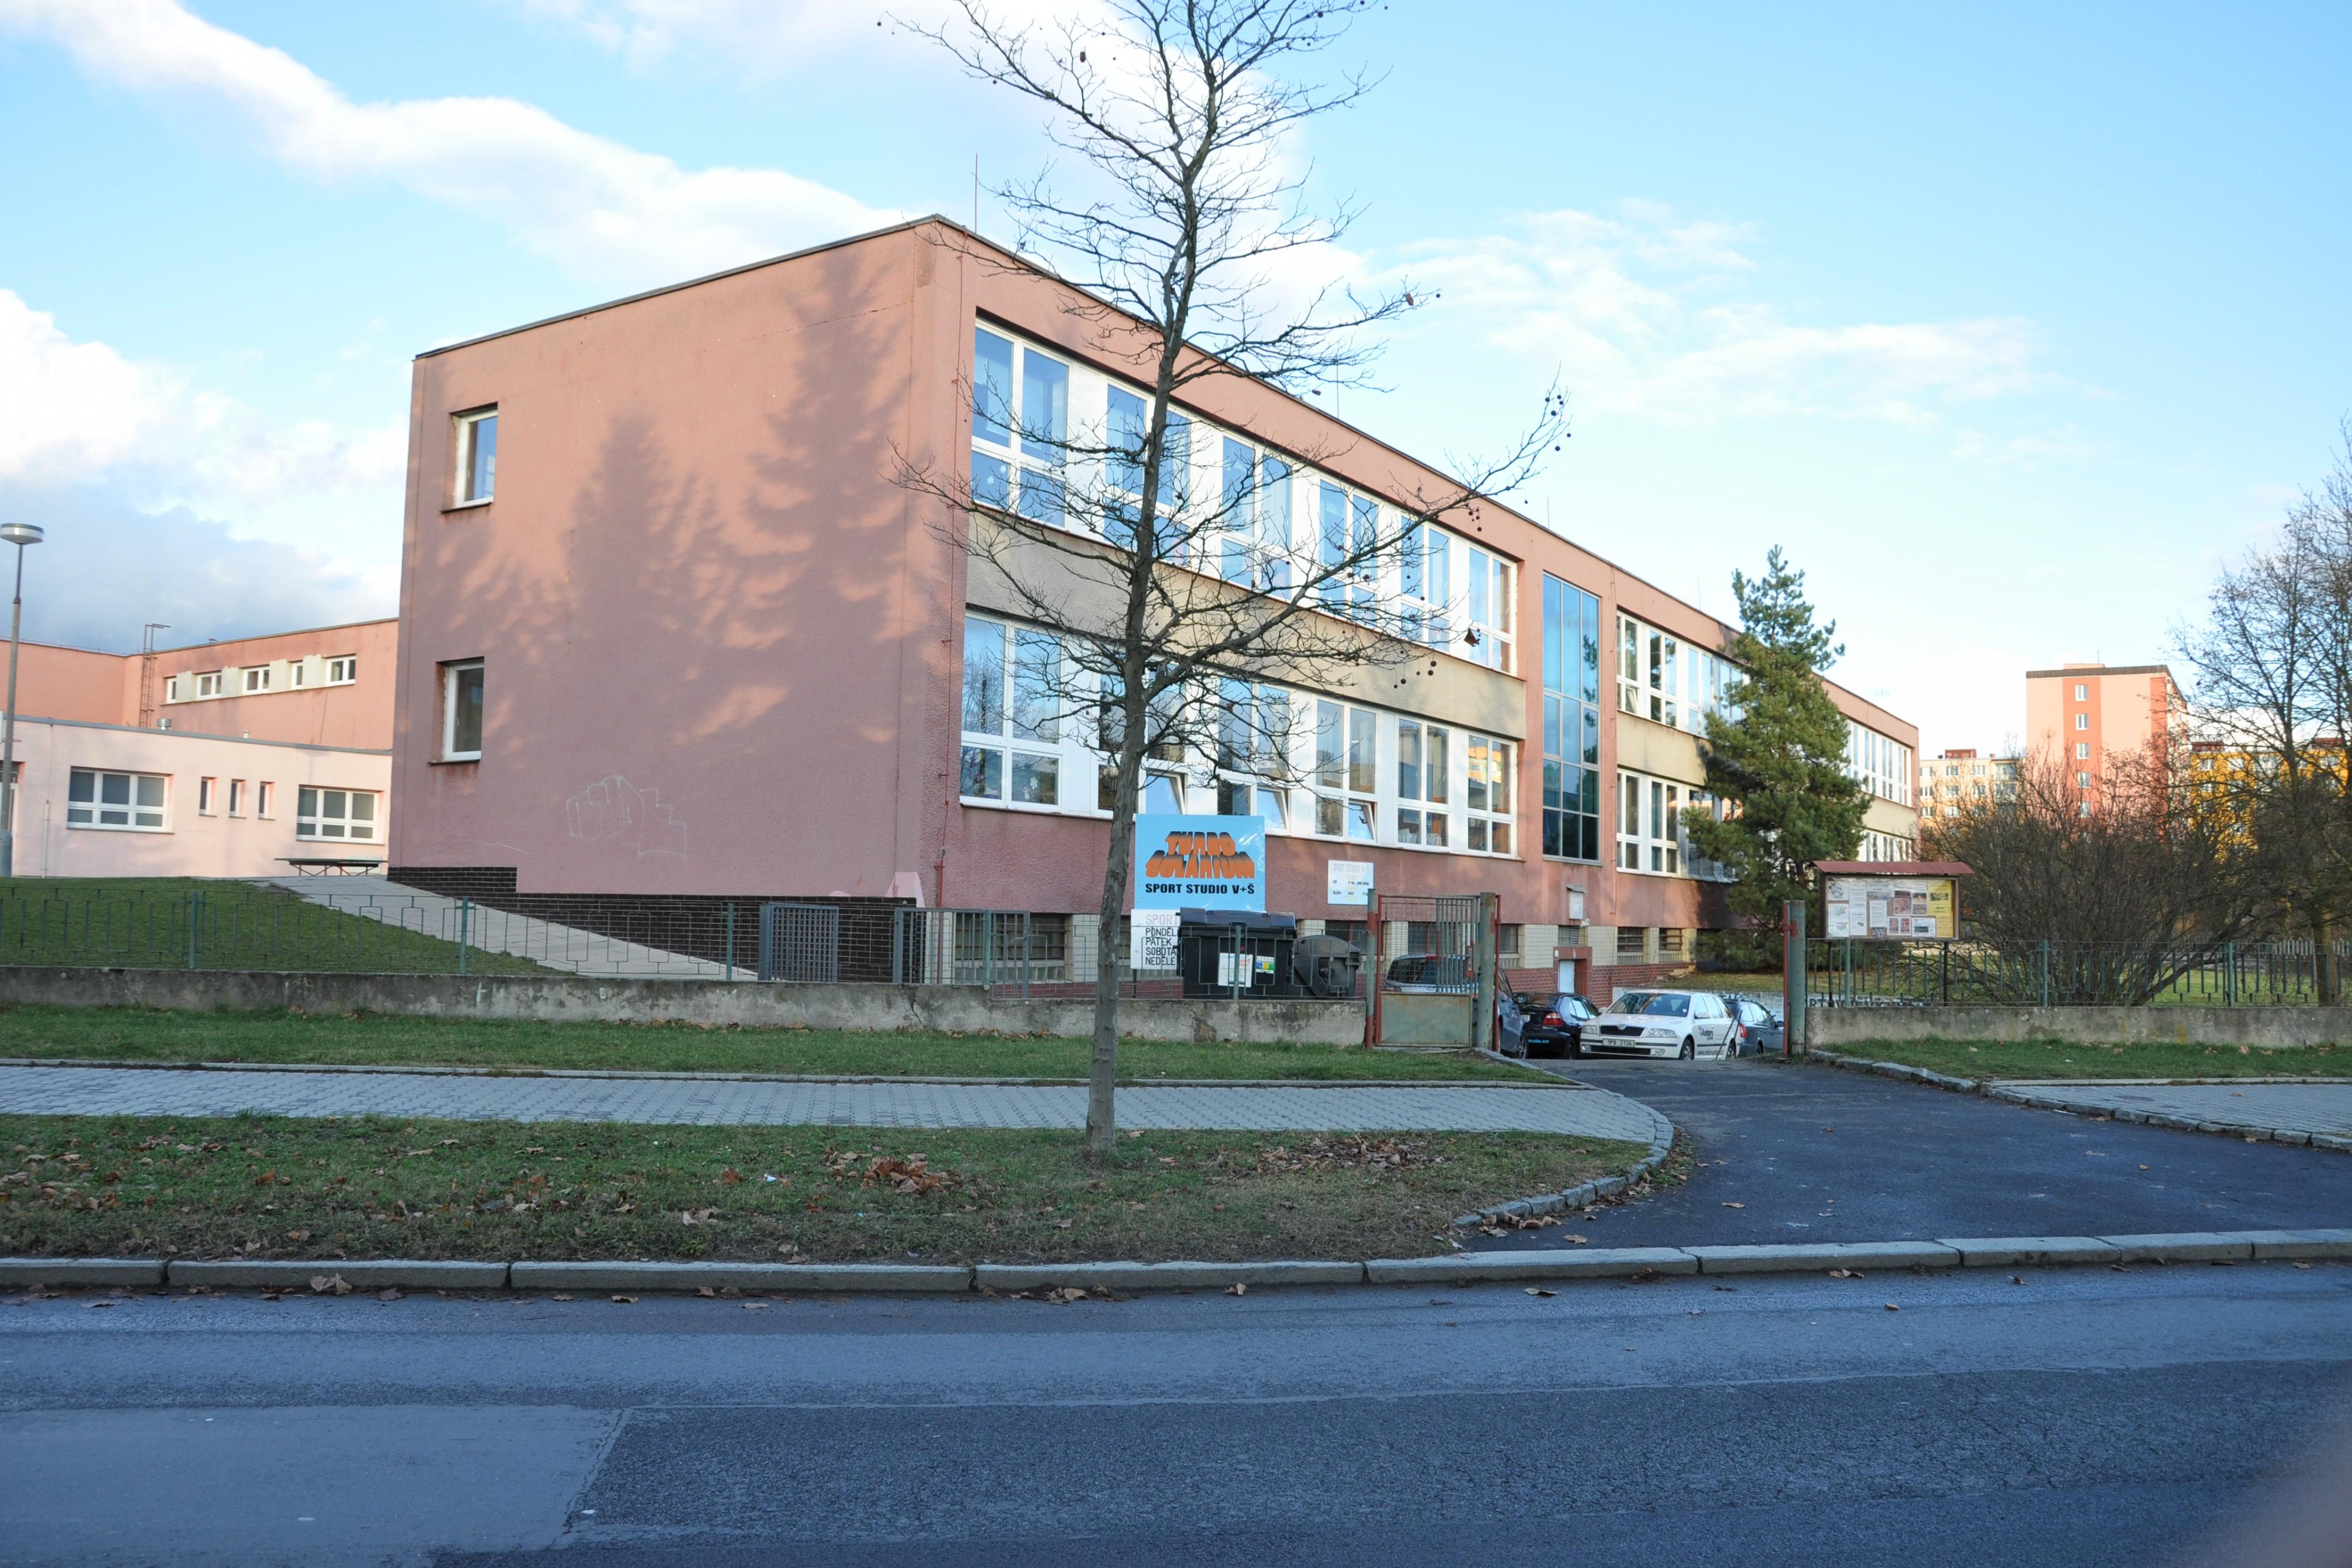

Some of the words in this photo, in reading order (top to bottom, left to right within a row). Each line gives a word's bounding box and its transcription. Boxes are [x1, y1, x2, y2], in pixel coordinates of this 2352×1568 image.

[1165, 831, 1236, 856] TURBO
[1146, 850, 1255, 878] SOLARIUM
[1145, 883, 1182, 893] SPORT
[1186, 884, 1227, 894] STUDIO
[1232, 883, 1255, 894] V+Š
[1146, 914, 1180, 925] SPORT
[1145, 927, 1177, 936] PONDĚL
[1146, 947, 1177, 955] SOBOTA
